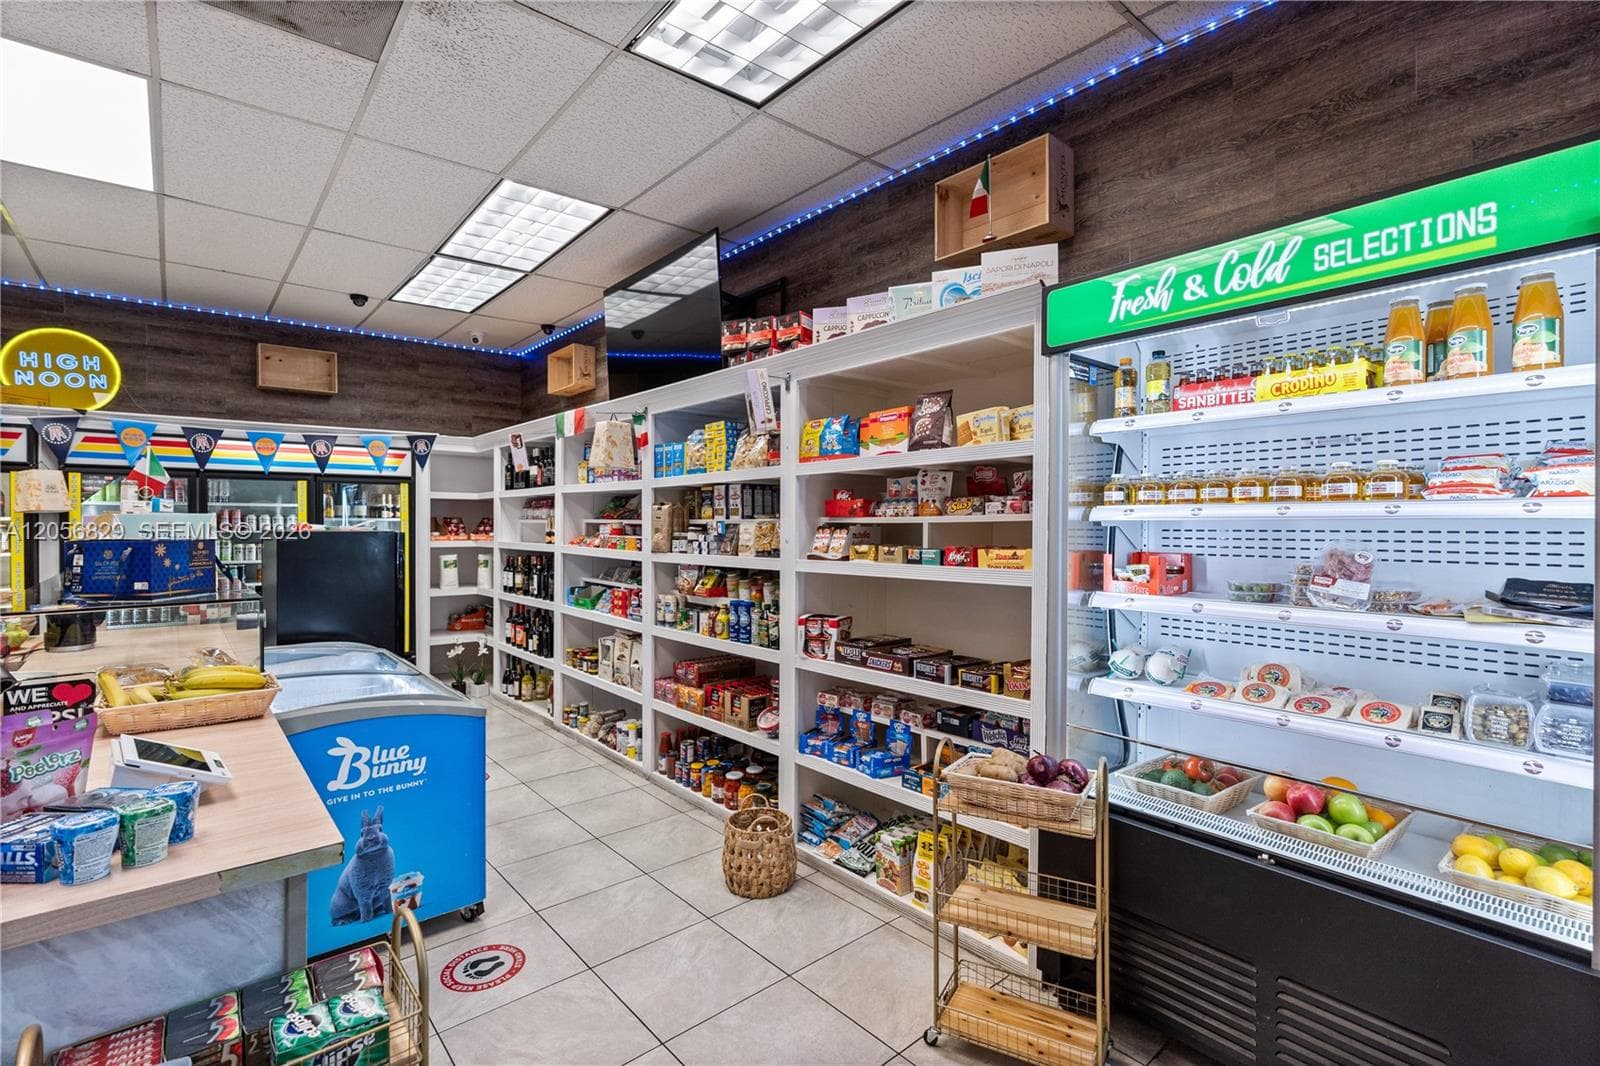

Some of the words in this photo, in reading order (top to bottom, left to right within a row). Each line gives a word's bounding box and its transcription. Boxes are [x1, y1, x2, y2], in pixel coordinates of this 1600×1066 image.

[1108, 265, 1177, 324] Fresh
[1183, 274, 1208, 301] &
[1213, 235, 1303, 297] Cold
[1313, 201, 1498, 272] SELECTIONS
[858, 312, 889, 321] CAPPUCCIN
[19, 351, 101, 372] HIGH
[14, 370, 108, 390] NOON
[1270, 372, 1338, 398] CRODINO
[1178, 391, 1256, 410] SANBITTER
[6, 687, 48, 706] WE
[28, 701, 68, 710] APPRECIATE
[326, 794, 348, 806] GIVE
[352, 792, 360, 801] IN
[364, 789, 376, 798] TO
[378, 786, 394, 795] THE
[396, 779, 424, 792] BUNNY
[348, 952, 361, 972] 5
[280, 974, 294, 994] 5
